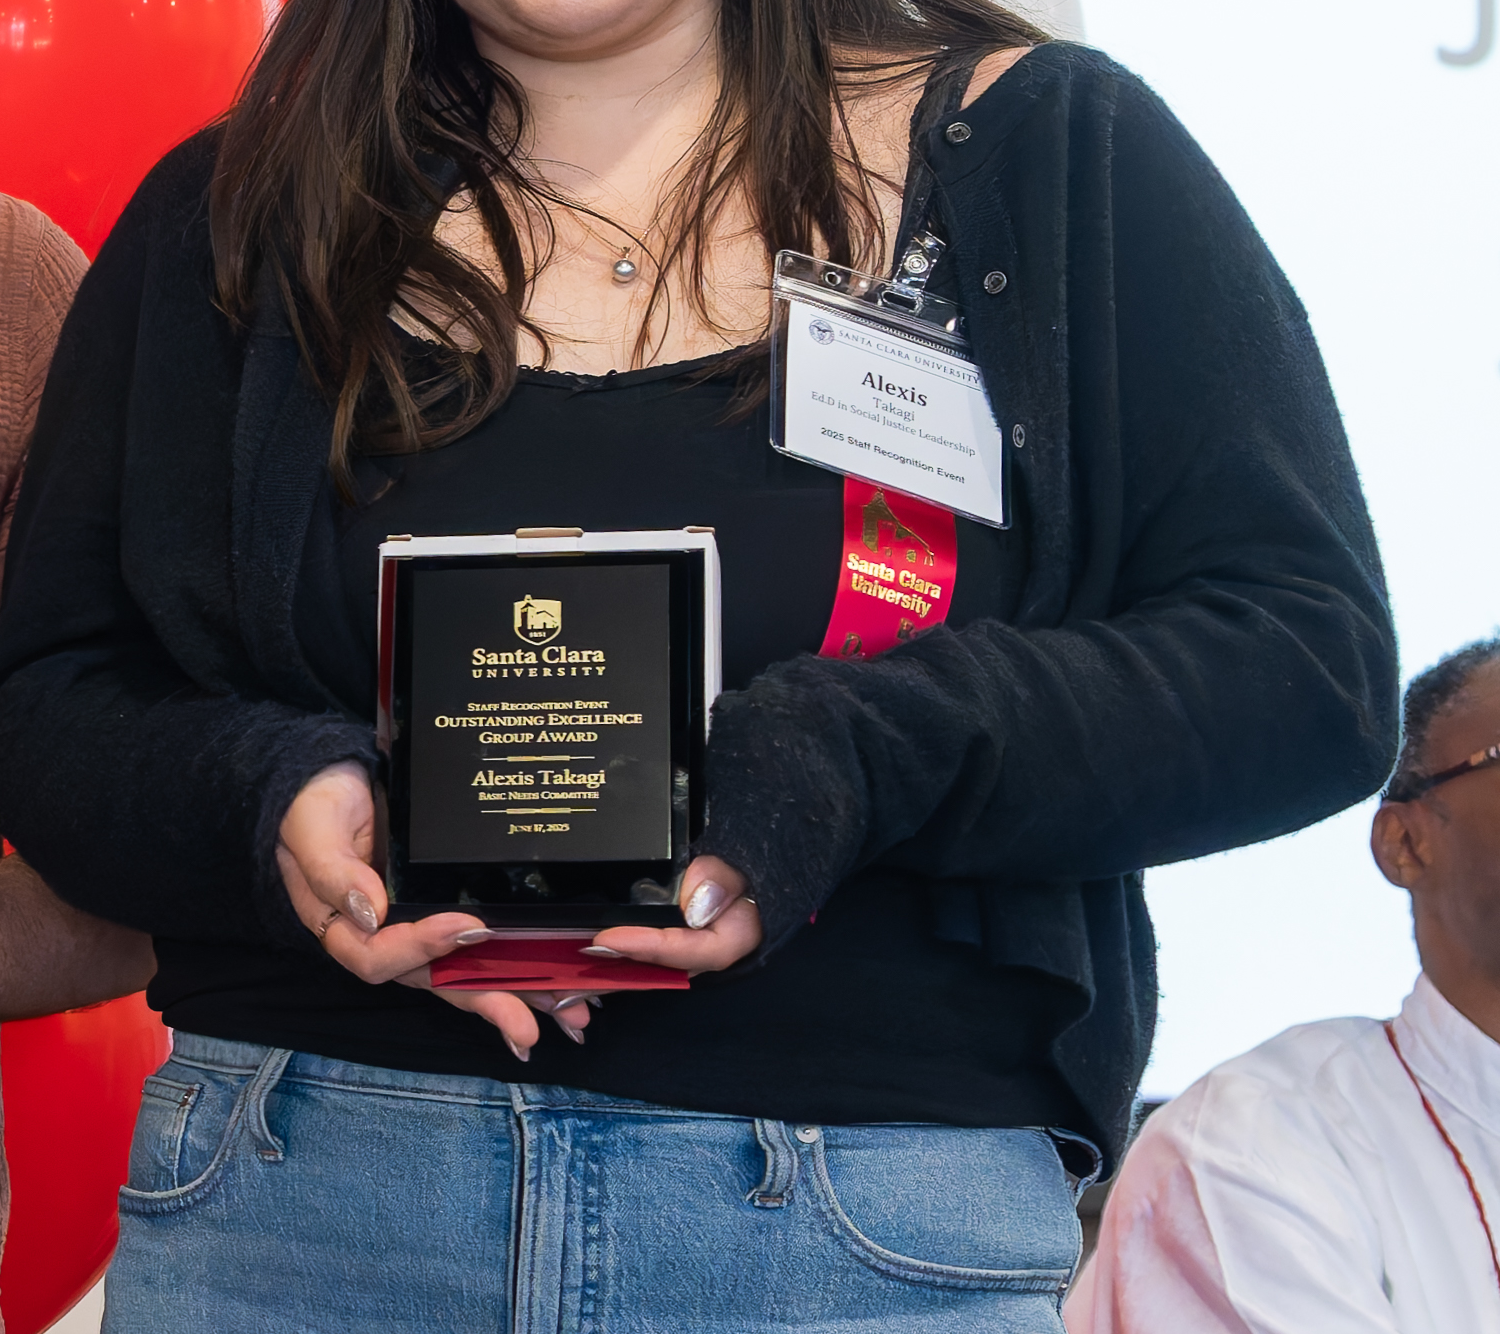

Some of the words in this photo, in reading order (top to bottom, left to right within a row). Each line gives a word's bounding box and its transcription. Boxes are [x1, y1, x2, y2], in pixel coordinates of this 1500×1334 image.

[839, 330, 873, 347] SANTA
[876, 343, 911, 361] CLARA
[914, 356, 981, 385] UNIVERSITY
[861, 371, 928, 407] Alexis
[872, 396, 916, 423] Takagi
[811, 391, 835, 407] Ed.D
[837, 400, 848, 411] in
[850, 402, 880, 423] Social
[882, 416, 917, 436] Justice
[918, 428, 977, 457] Leadership
[821, 427, 845, 442] 2025
[847, 436, 871, 451] Staff
[873, 445, 935, 473] Recognition
[936, 467, 966, 484] Event
[847, 553, 895, 582] Santa
[899, 570, 942, 599] Clara
[851, 572, 932, 619] University
[472, 648, 538, 665] Santa
[542, 646, 606, 663] Clara
[472, 666, 606, 679] UNIVERSITY
[468, 702, 499, 711] STAFF
[501, 701, 573, 711] RECOGNITION
[574, 700, 610, 710] EVENT
[435, 714, 545, 728] OUTSTANDING
[548, 713, 643, 726] EXCELLENCE
[479, 731, 534, 744] GROUP
[536, 730, 598, 743] AWARD
[471, 770, 535, 786] Alexis
[537, 768, 606, 789] Takagi
